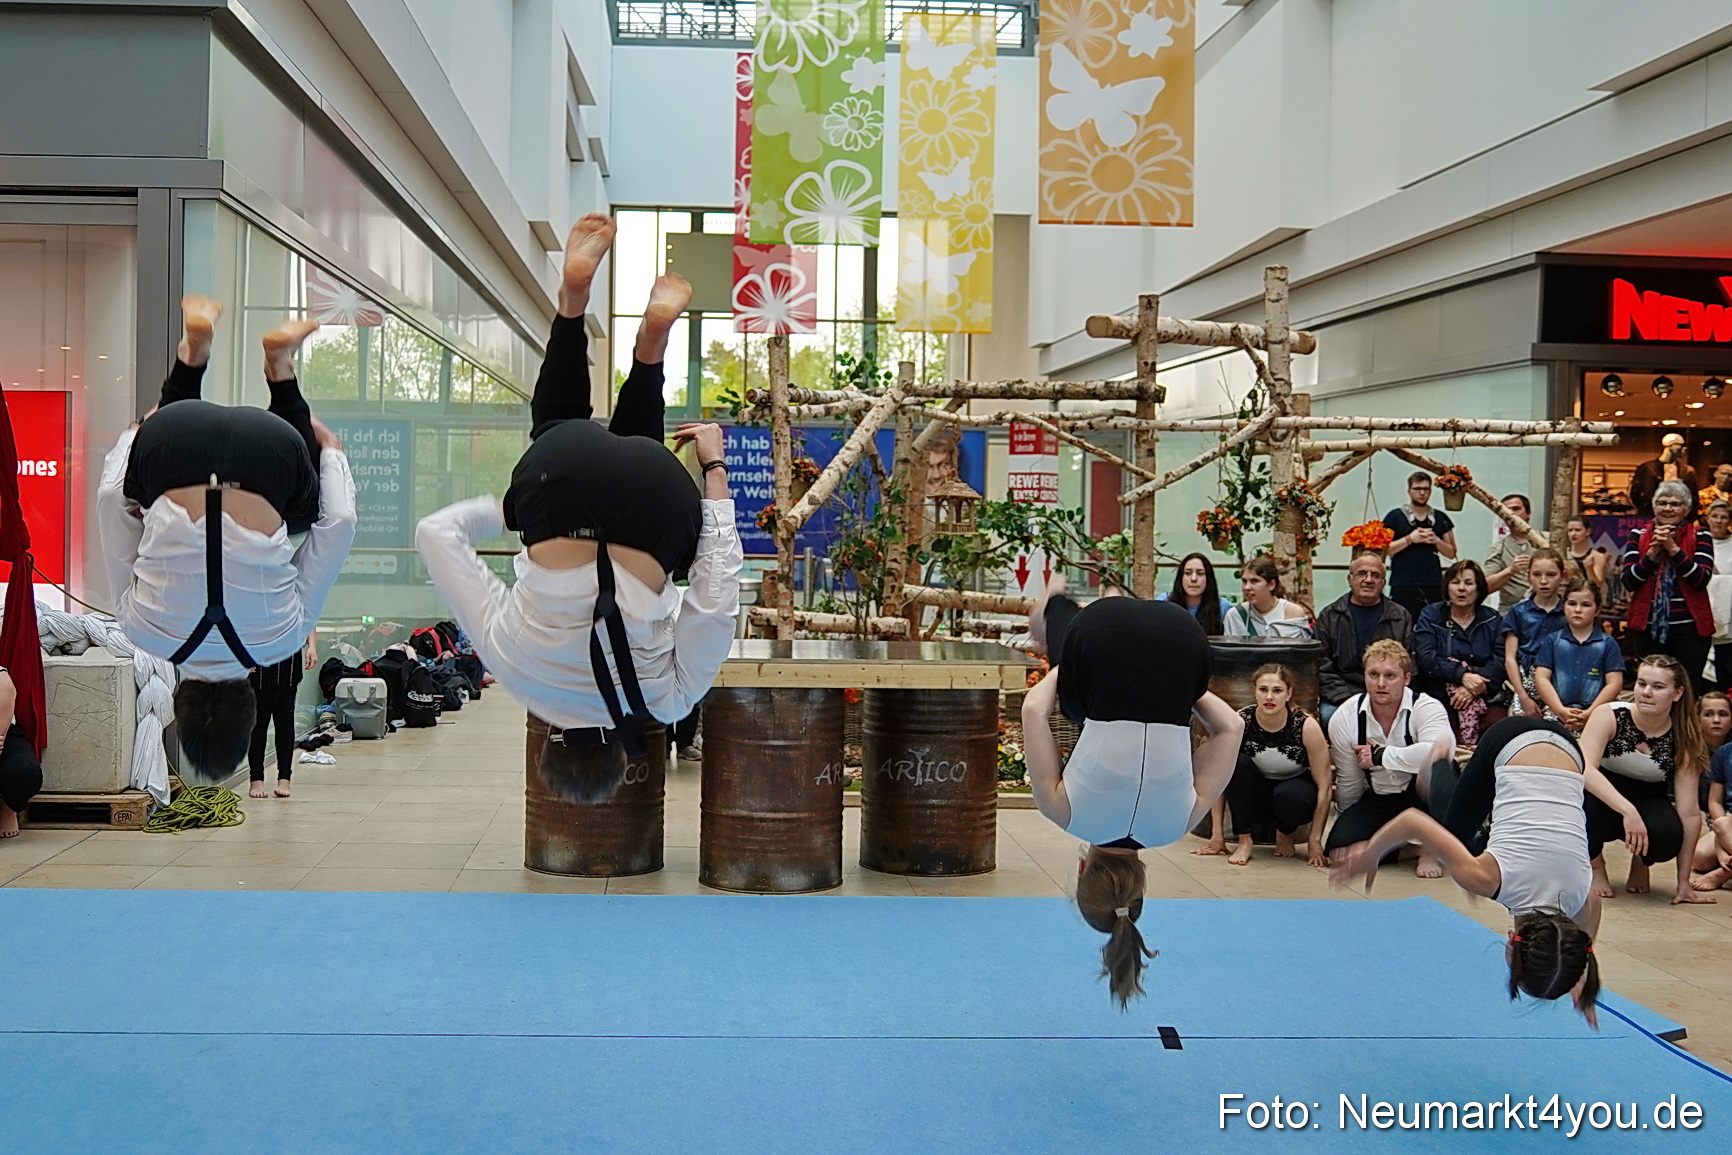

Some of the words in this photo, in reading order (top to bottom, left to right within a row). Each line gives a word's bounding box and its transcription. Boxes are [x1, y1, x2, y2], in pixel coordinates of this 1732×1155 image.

[723, 435, 738, 449] ch
[742, 435, 770, 450] hab
[725, 455, 743, 466] en
[1009, 474, 1040, 489] REWE
[813, 762, 842, 786] AR
